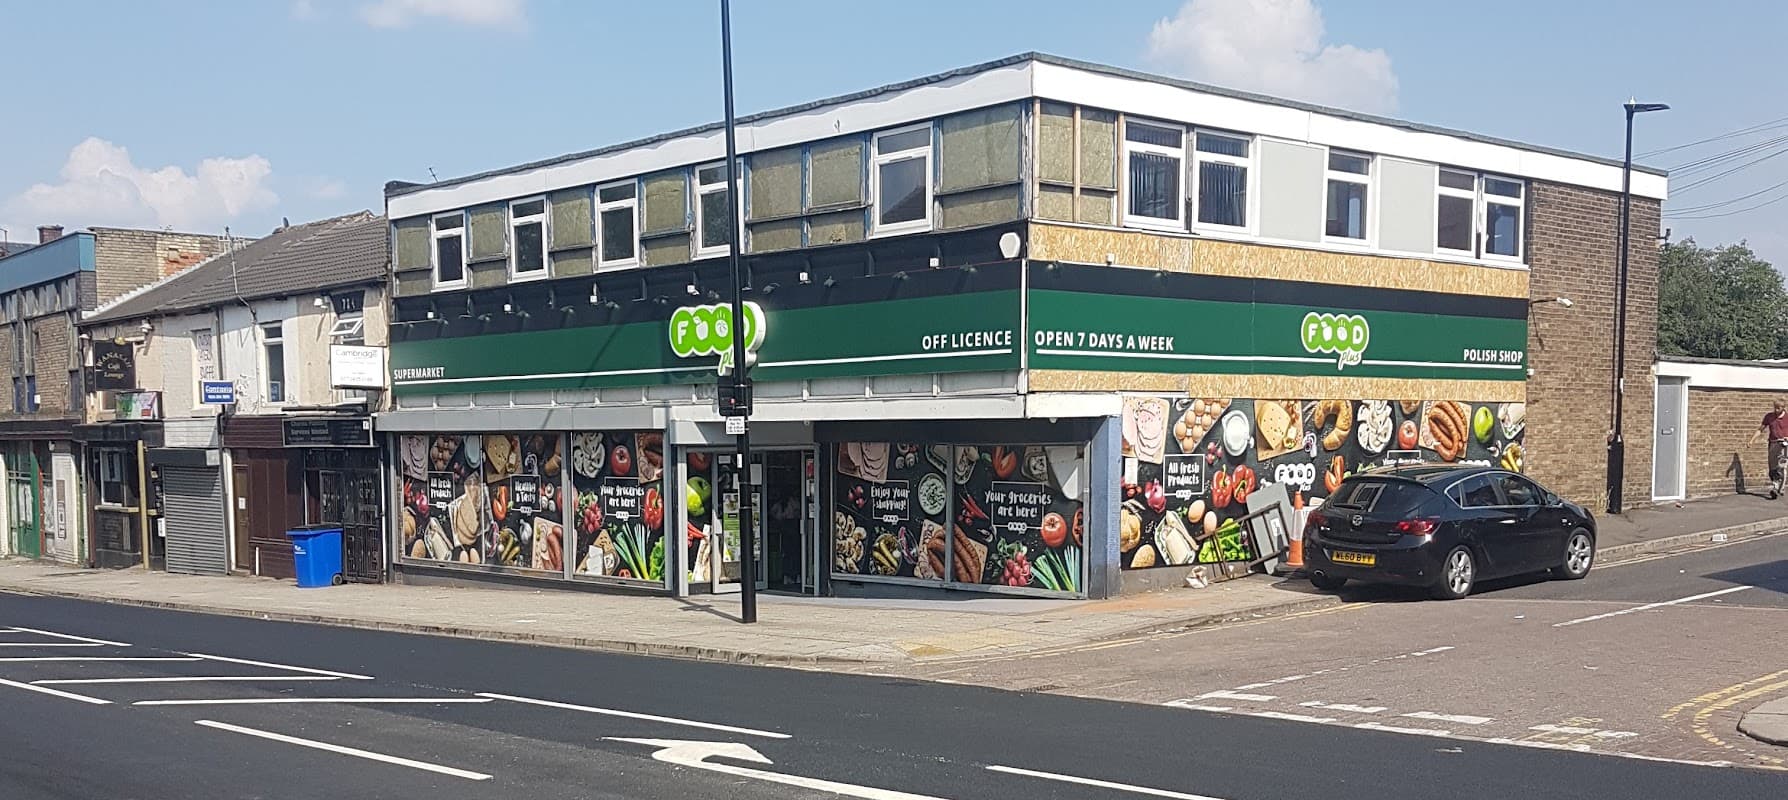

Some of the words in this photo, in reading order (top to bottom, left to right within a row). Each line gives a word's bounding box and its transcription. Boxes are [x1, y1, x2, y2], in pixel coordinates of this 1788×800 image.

[1308, 320, 1364, 345] FOOD
[922, 334, 948, 350] OFF
[951, 330, 1012, 348] LICENCE
[1034, 330, 1074, 347] OPEN
[1077, 332, 1086, 347] 7
[1089, 333, 1124, 349] DAYS
[1126, 335, 1136, 350] A
[1138, 336, 1174, 351] WEEK
[336, 349, 378, 359] Cambridge
[1340, 350, 1360, 365] plus
[1463, 348, 1497, 362] POLISH
[1499, 350, 1523, 363] SHOP
[393, 366, 445, 380] SUPERMARKET
[1168, 462, 1178, 474] All
[1180, 462, 1200, 475] fresh
[1278, 467, 1313, 481] FOOD
[514, 480, 536, 493] Healthy
[1167, 474, 1200, 487] Products
[521, 493, 536, 503] Tasty
[615, 485, 645, 497] groceries
[871, 485, 890, 499] Enjoy
[1008, 491, 1052, 505] groceries
[609, 497, 620, 507] are
[998, 505, 1013, 517] are
[1015, 505, 1038, 518] here!
